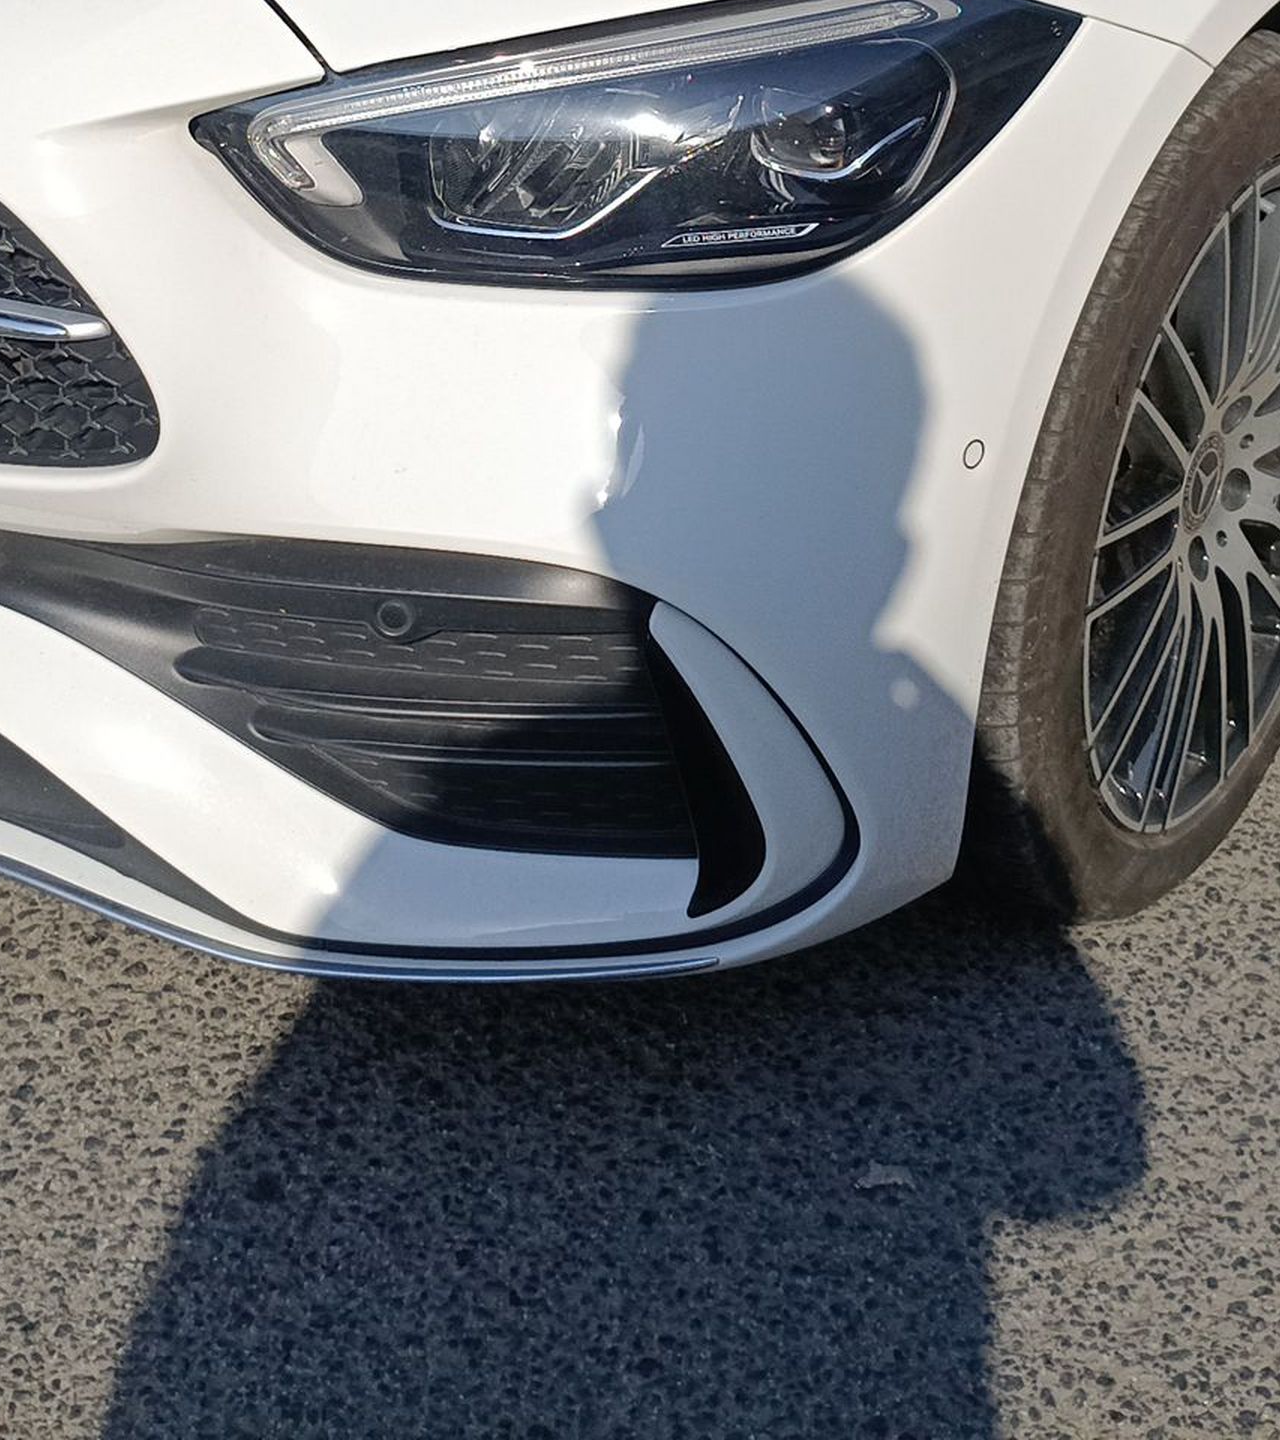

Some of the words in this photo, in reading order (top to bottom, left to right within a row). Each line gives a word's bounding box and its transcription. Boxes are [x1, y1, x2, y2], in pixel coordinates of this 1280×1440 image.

[682, 235, 700, 244] LED
[702, 232, 726, 242] HIGH
[727, 227, 797, 241] PERFORMANCE
